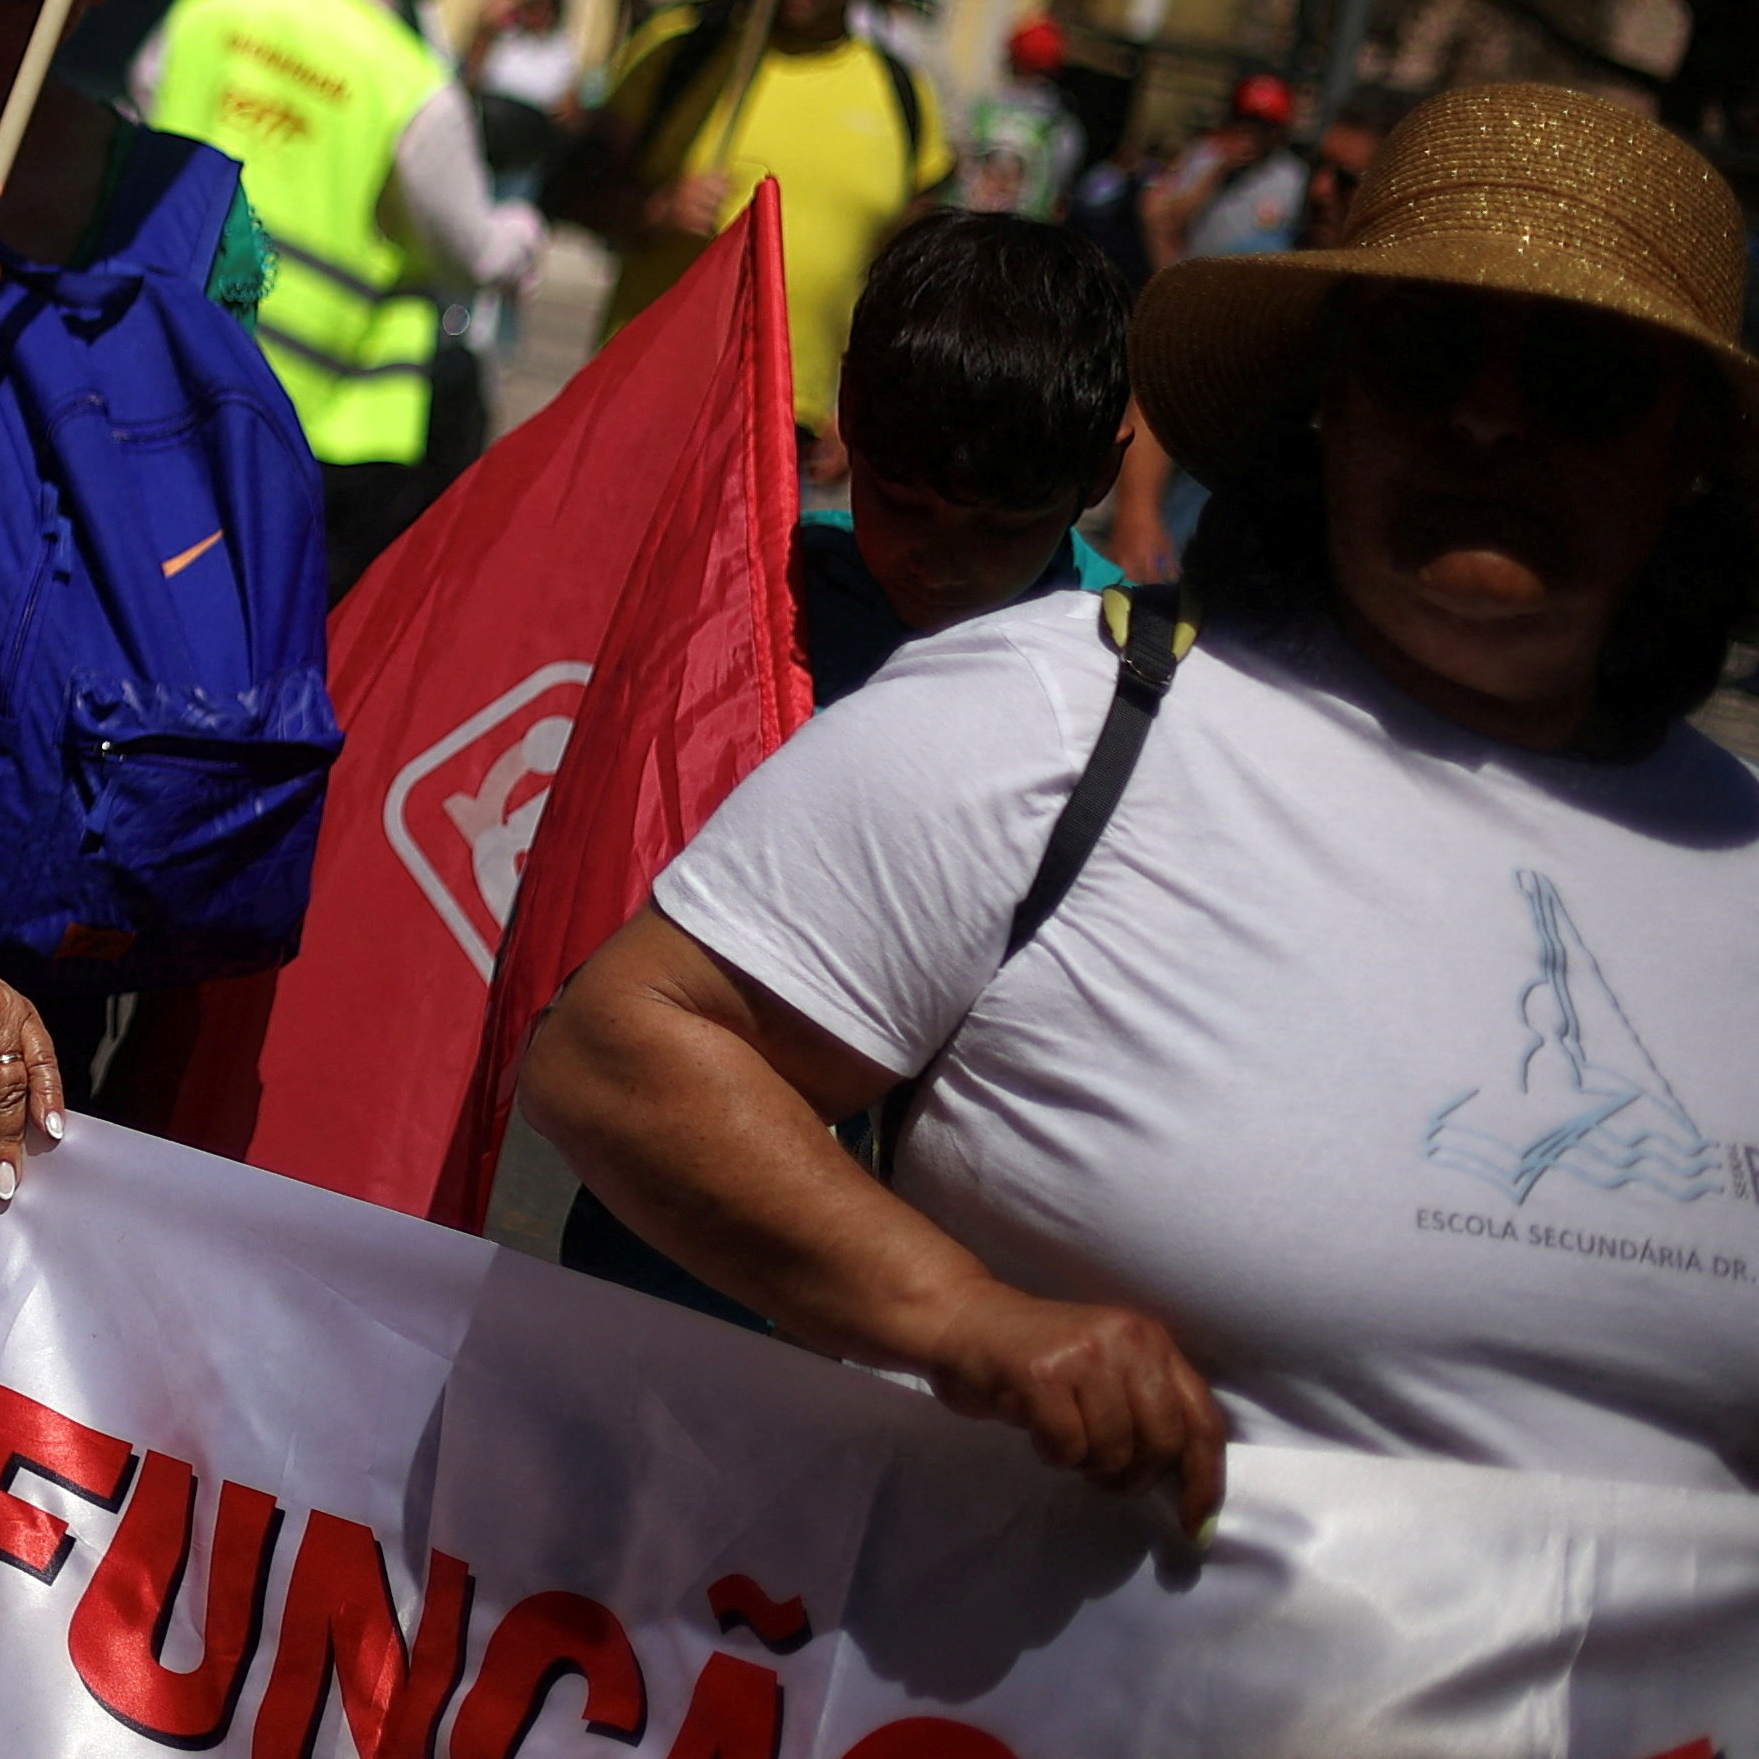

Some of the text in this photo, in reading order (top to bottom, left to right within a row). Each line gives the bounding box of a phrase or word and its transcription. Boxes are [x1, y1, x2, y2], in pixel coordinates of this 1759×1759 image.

[1415, 1207, 1757, 1284] ESCOLA SECUNDÁRIA DR.
